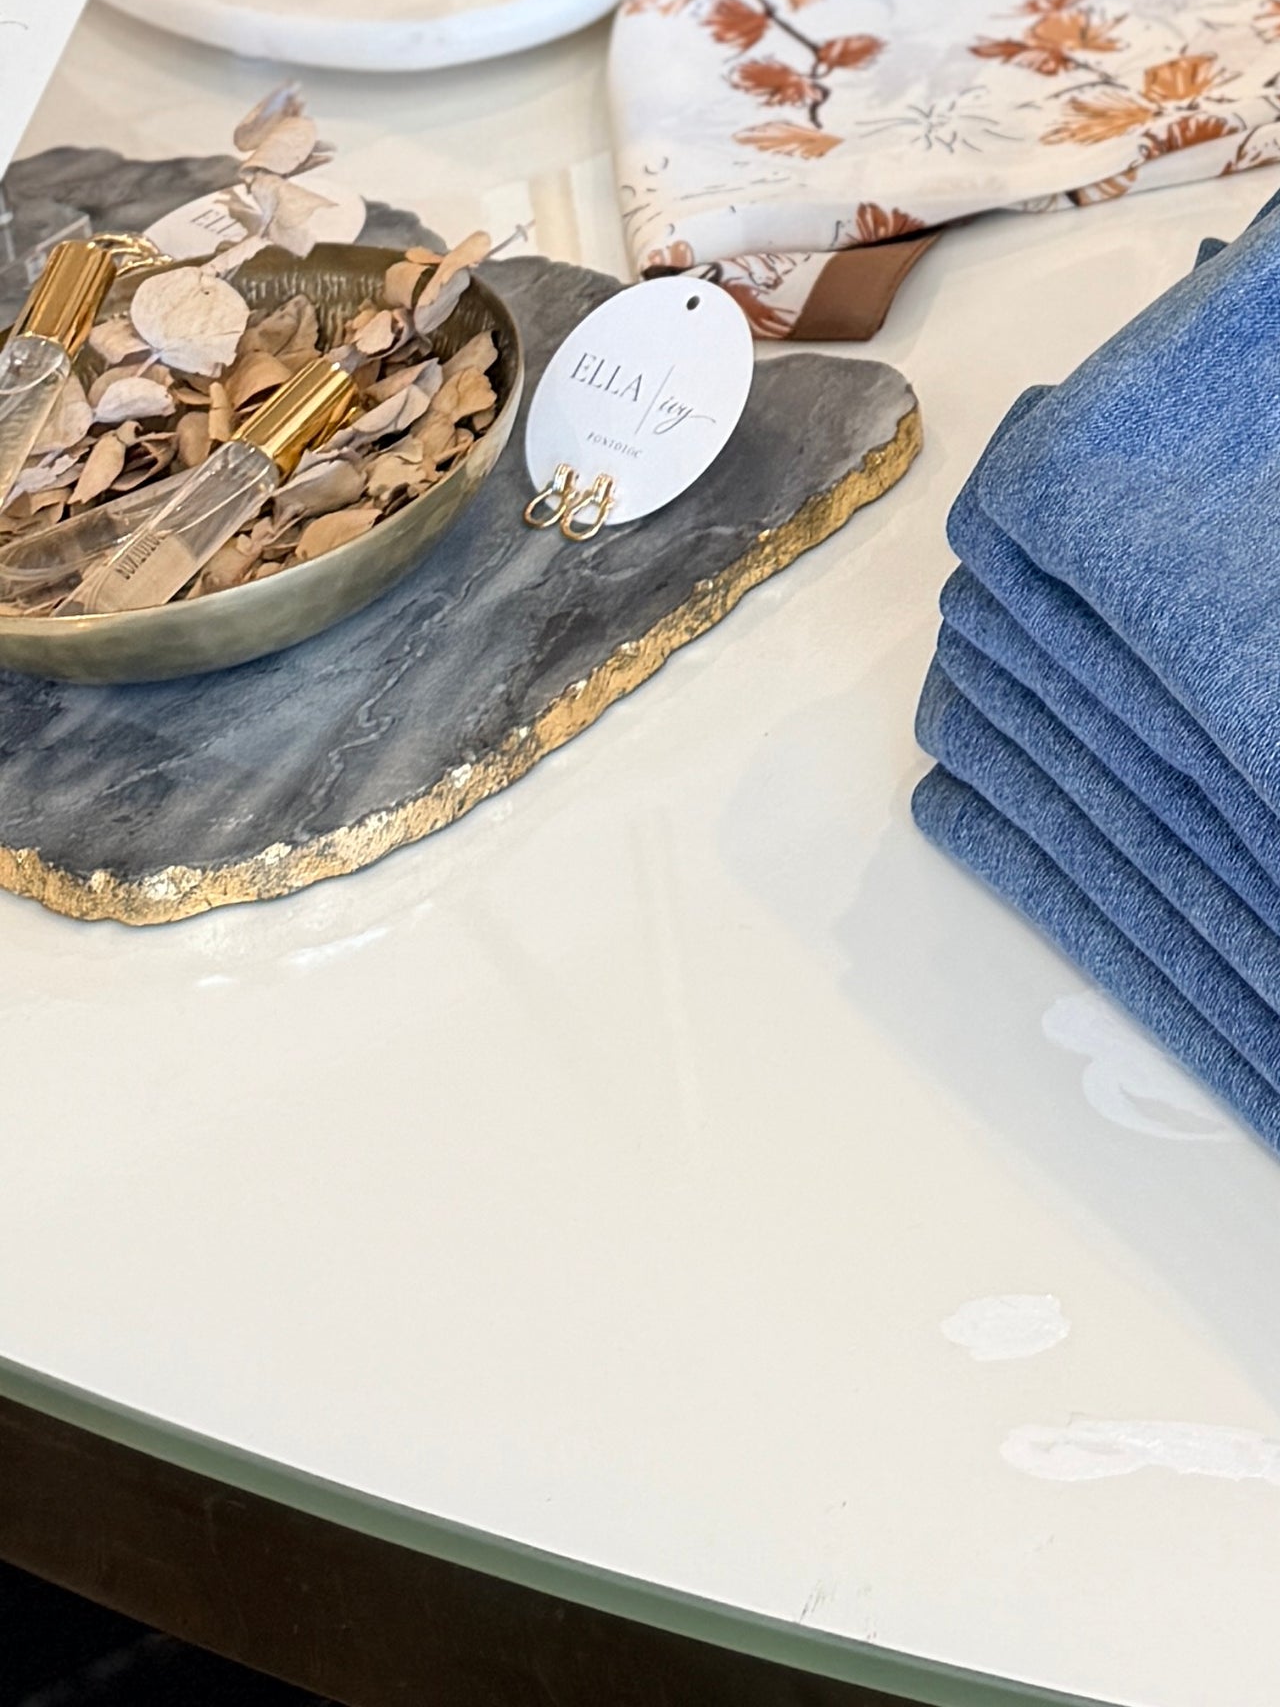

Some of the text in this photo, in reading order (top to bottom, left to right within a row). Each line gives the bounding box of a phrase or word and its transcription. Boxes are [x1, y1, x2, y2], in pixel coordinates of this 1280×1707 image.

[190, 208, 246, 235] ELL
[569, 352, 717, 435] ELLA ivy
